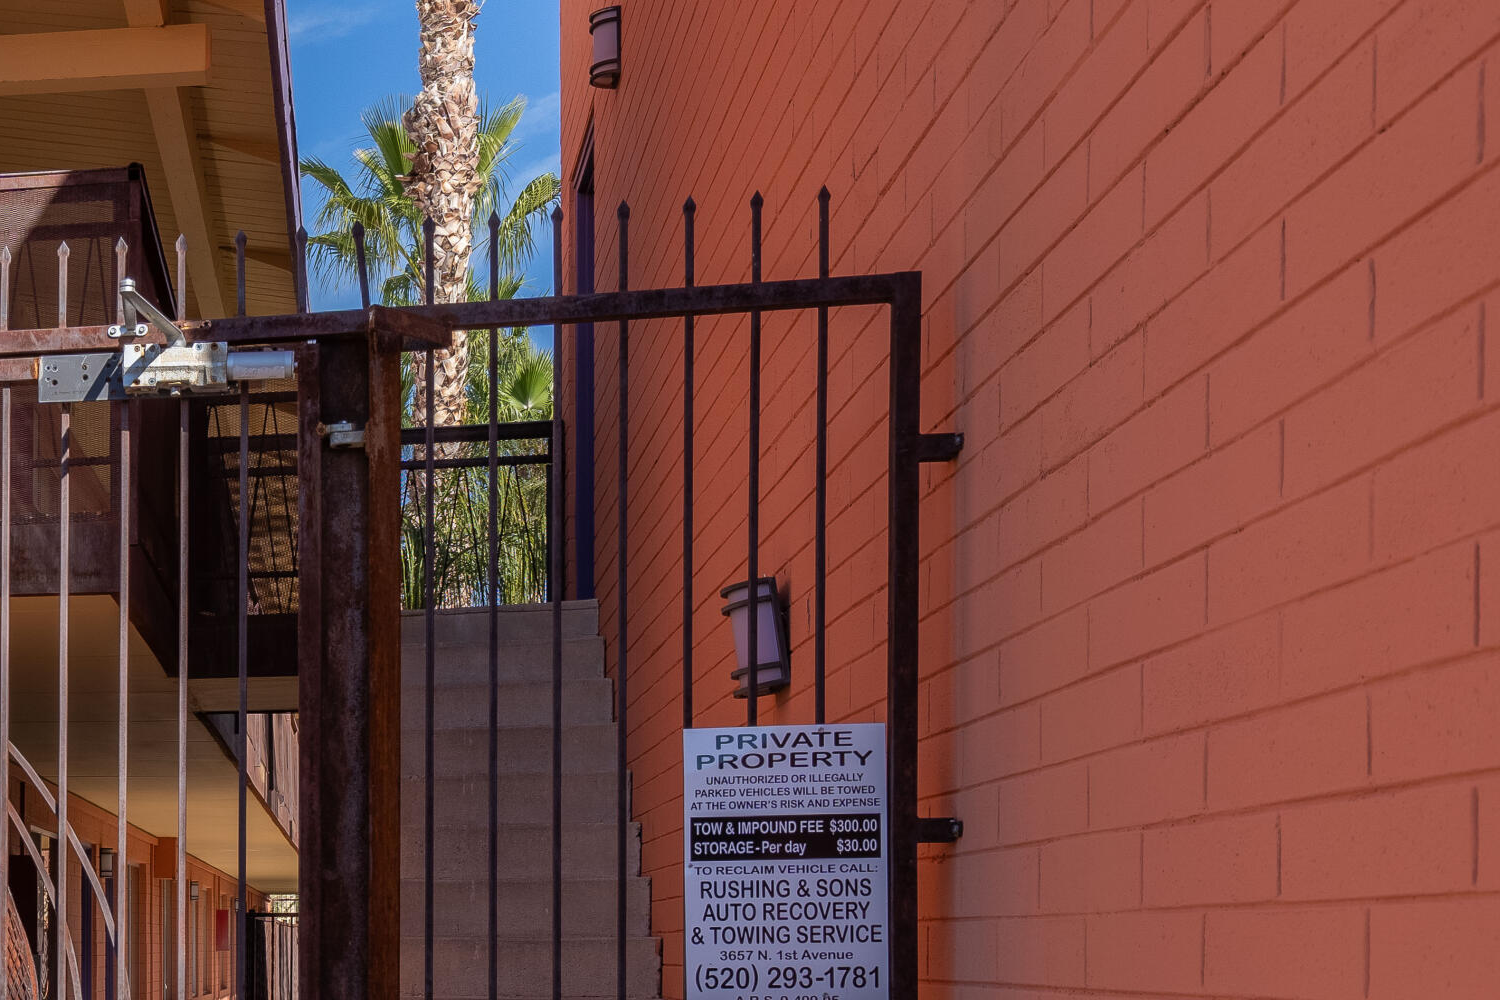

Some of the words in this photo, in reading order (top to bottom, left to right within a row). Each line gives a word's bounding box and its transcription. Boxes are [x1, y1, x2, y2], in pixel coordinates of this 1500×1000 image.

[715, 731, 853, 750] PRIVATE
[696, 750, 873, 770] PROPERTY
[706, 774, 788, 785] UNAUTHORIZED
[791, 774, 806, 783] OR
[809, 773, 864, 783] ILLEGALLY
[695, 789, 736, 798] PARKED
[739, 788, 790, 797] VEHICLES
[793, 787, 818, 796] WILL
[821, 786, 834, 795] BE
[837, 785, 875, 794] TOWED
[690, 802, 703, 811] AT
[706, 801, 726, 810] THE
[728, 800, 777, 809] OWNER'S
[780, 799, 804, 808] RISK
[807, 799, 830, 808] AND
[833, 798, 880, 807] EXPENSE
[694, 822, 723, 836] TOW
[725, 822, 735, 835] &
[738, 821, 797, 835] IMPOUND
[800, 820, 823, 833] FEE
[830, 819, 877, 835] $300.00
[785, 840, 806, 856] day
[836, 838, 877, 854] $30.00
[694, 866, 712, 875] TO
[716, 865, 774, 875] RECLAIM
[778, 864, 836, 874] VEHICLE
[839, 864, 878, 873] CALL:
[700, 879, 790, 899] RUSHING
[797, 879, 810, 898] &
[816, 878, 872, 897] SONS
[702, 903, 756, 922] AUTO
[763, 901, 870, 921] RECOVERY
[691, 927, 704, 944] &
[710, 926, 790, 944] TOWING
[797, 925, 882, 944] SERVICE
[719, 951, 753, 961] 3657
[758, 951, 772, 961] N.
[777, 951, 798, 960] 1st
[801, 950, 853, 960] Avenue
[695, 964, 759, 992] (520)
[767, 966, 880, 990] 293-1781
